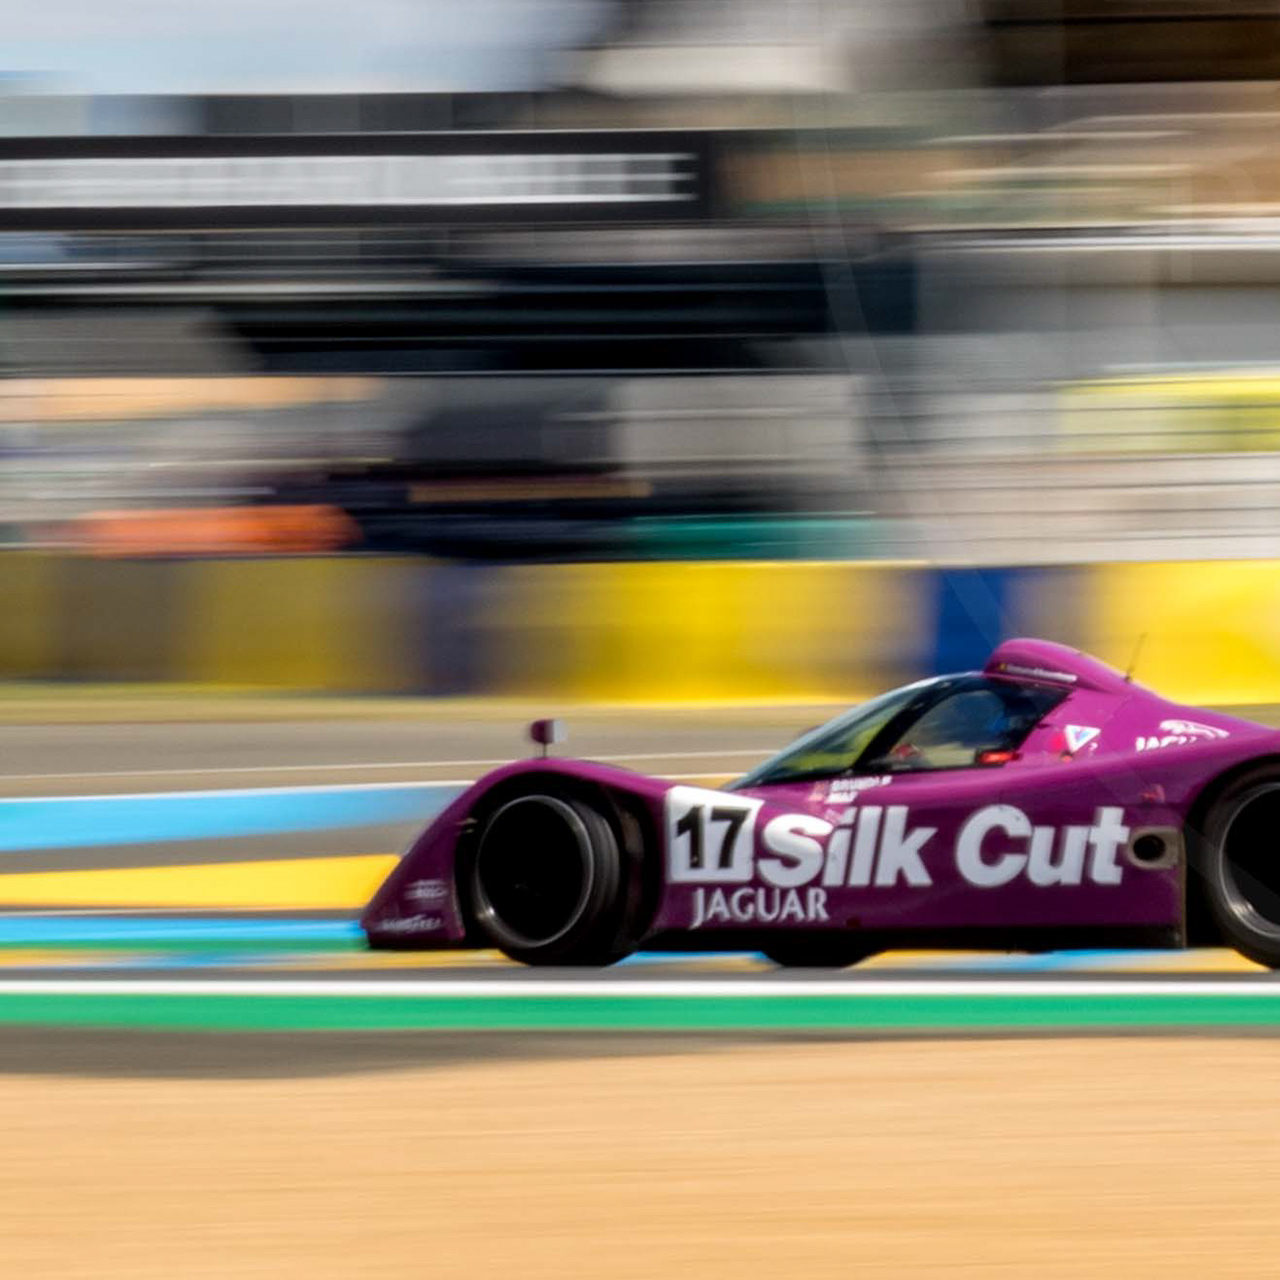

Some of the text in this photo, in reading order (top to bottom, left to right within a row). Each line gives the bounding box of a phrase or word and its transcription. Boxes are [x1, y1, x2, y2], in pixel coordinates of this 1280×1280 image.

[674, 804, 752, 871] 17
[757, 804, 1130, 888] Silk Cut
[690, 887, 828, 928] JAGUAR
